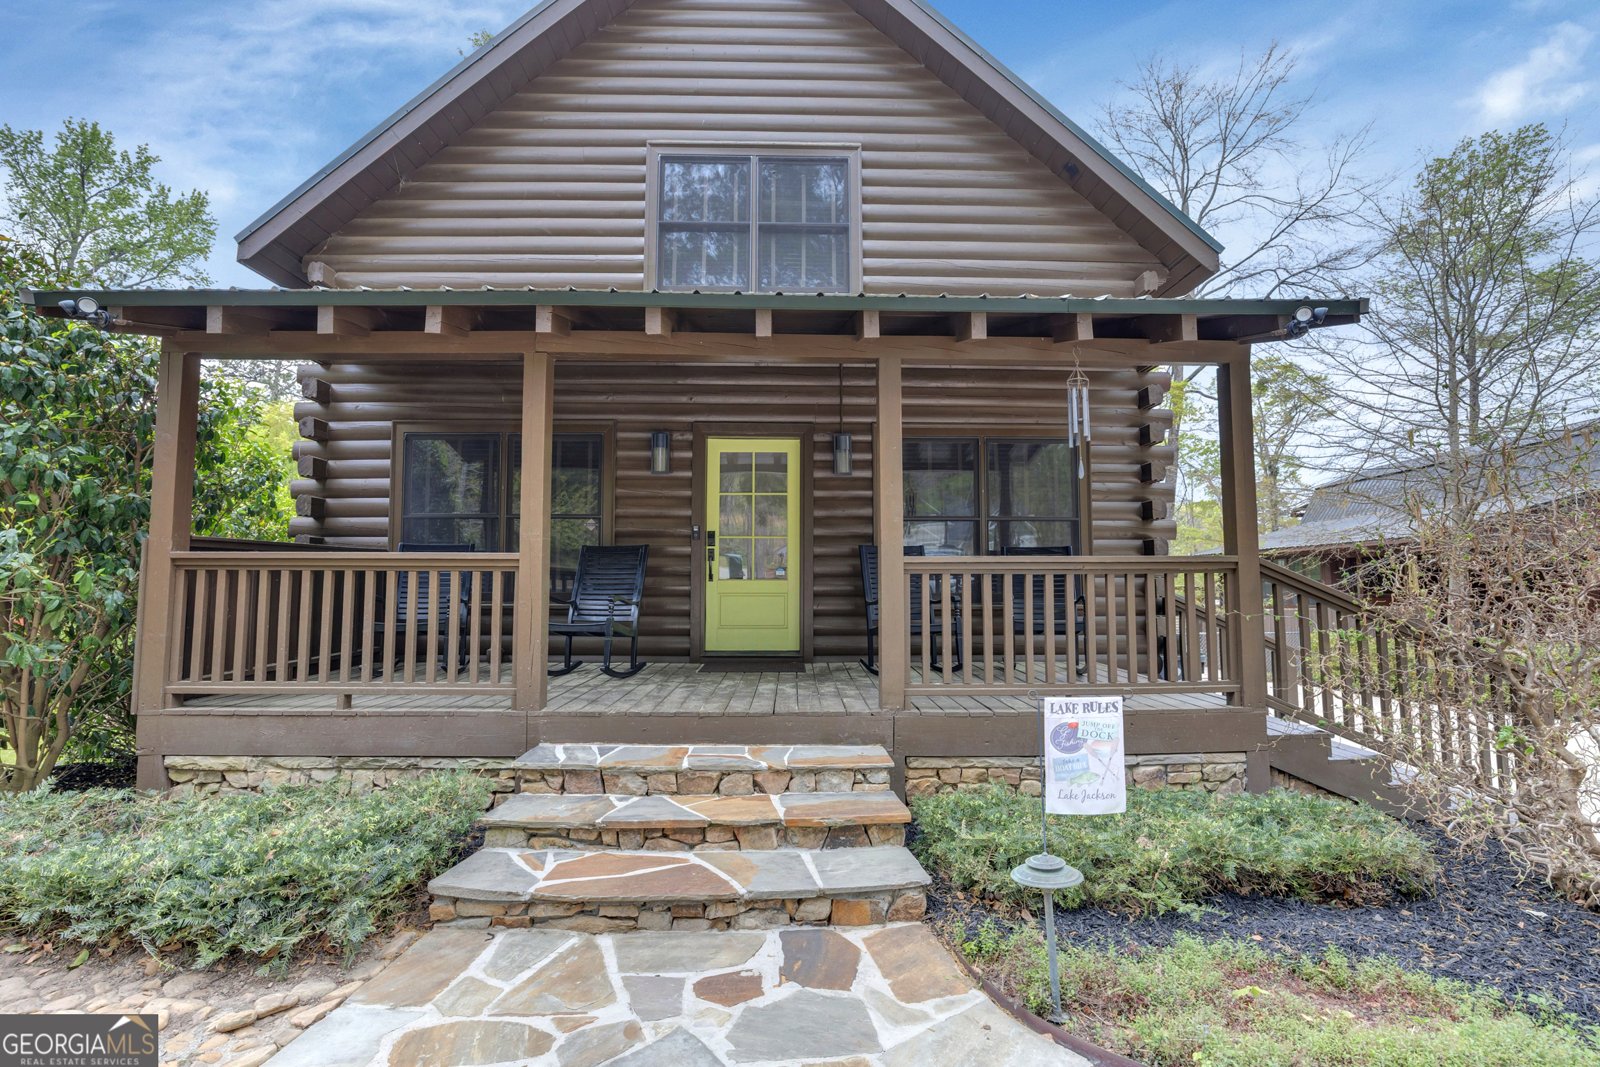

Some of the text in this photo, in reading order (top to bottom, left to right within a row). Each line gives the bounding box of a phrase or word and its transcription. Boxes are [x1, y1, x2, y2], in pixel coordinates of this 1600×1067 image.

[1050, 701, 1119, 714] LAKE RULES
[1081, 720, 1101, 728] JUMP
[1081, 729, 1114, 740] DOCK
[1058, 788, 1117, 803] Lake Jackson
